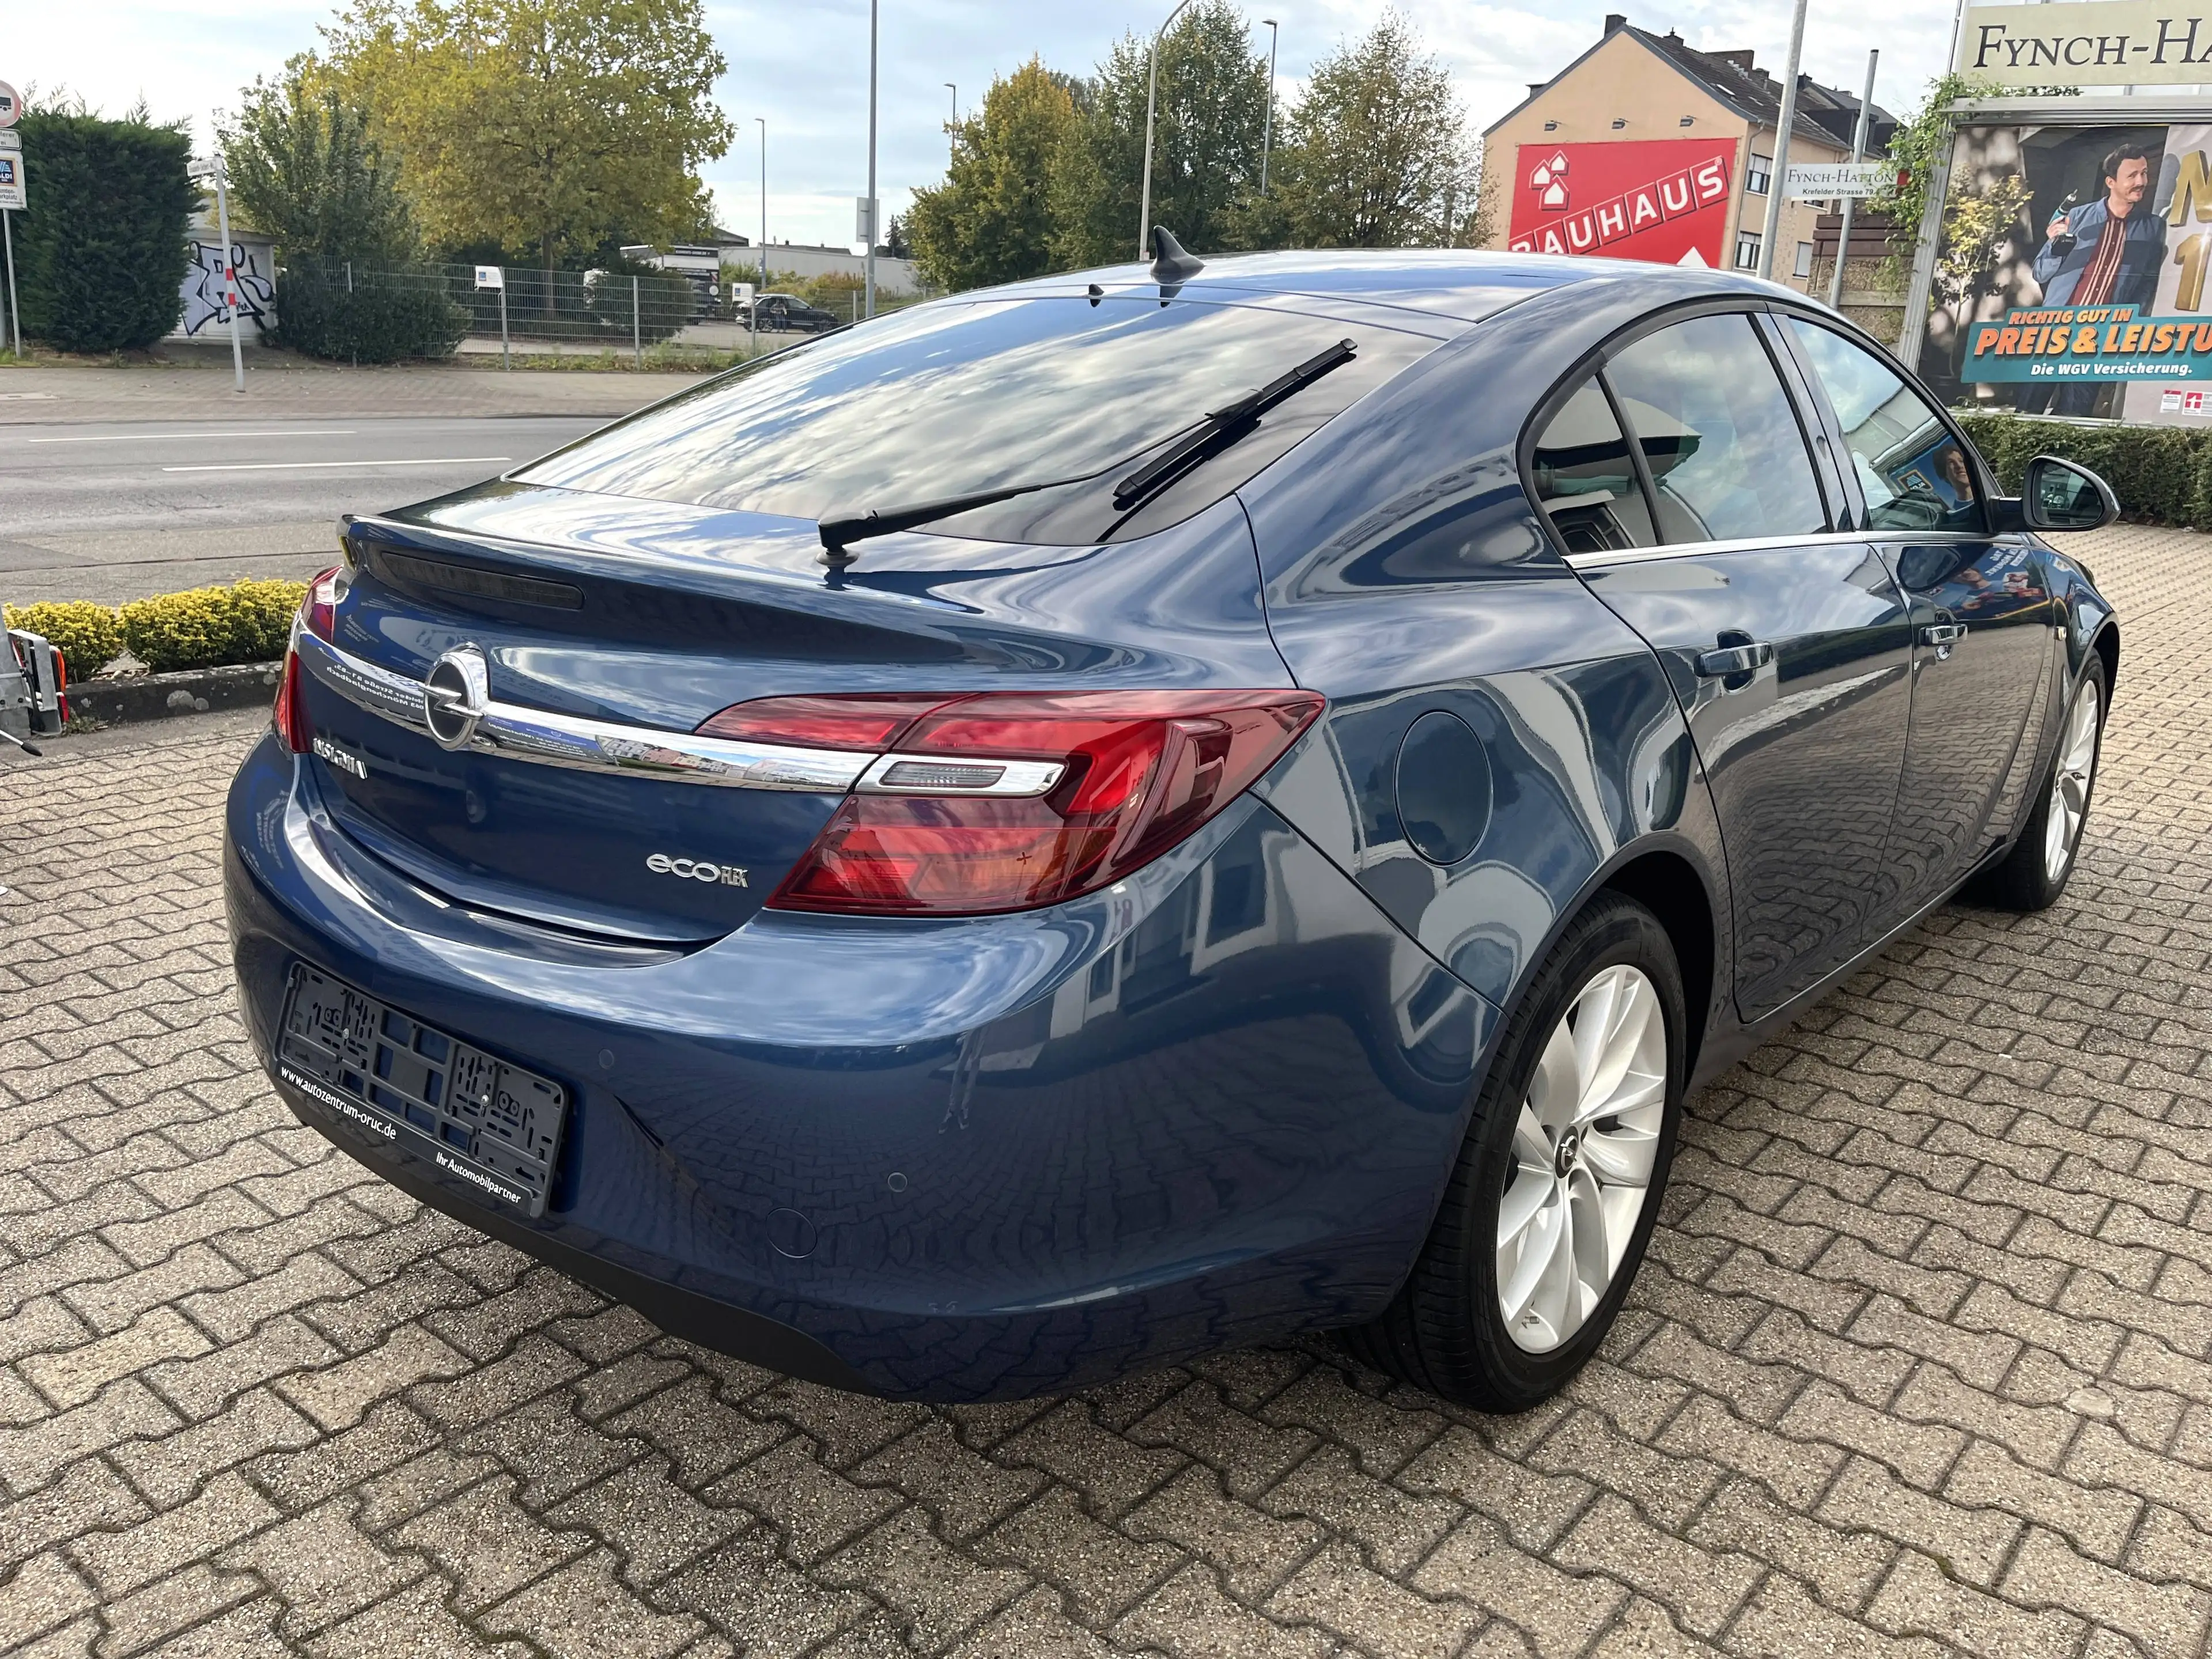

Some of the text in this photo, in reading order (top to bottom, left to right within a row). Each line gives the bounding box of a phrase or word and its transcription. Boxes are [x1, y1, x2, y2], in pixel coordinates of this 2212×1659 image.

[2009, 308, 2134, 325] RICHTIG GUT IN
[1974, 325, 2073, 357] PREIS
[2071, 326, 2098, 355] &
[2030, 362, 2193, 377] Die WGV Versicherung.
[313, 738, 368, 779] INSIGNIA
[281, 1067, 396, 1140] www.autozentrum-oruc.de
[436, 1152, 521, 1203] Ihr Automobilpartner
